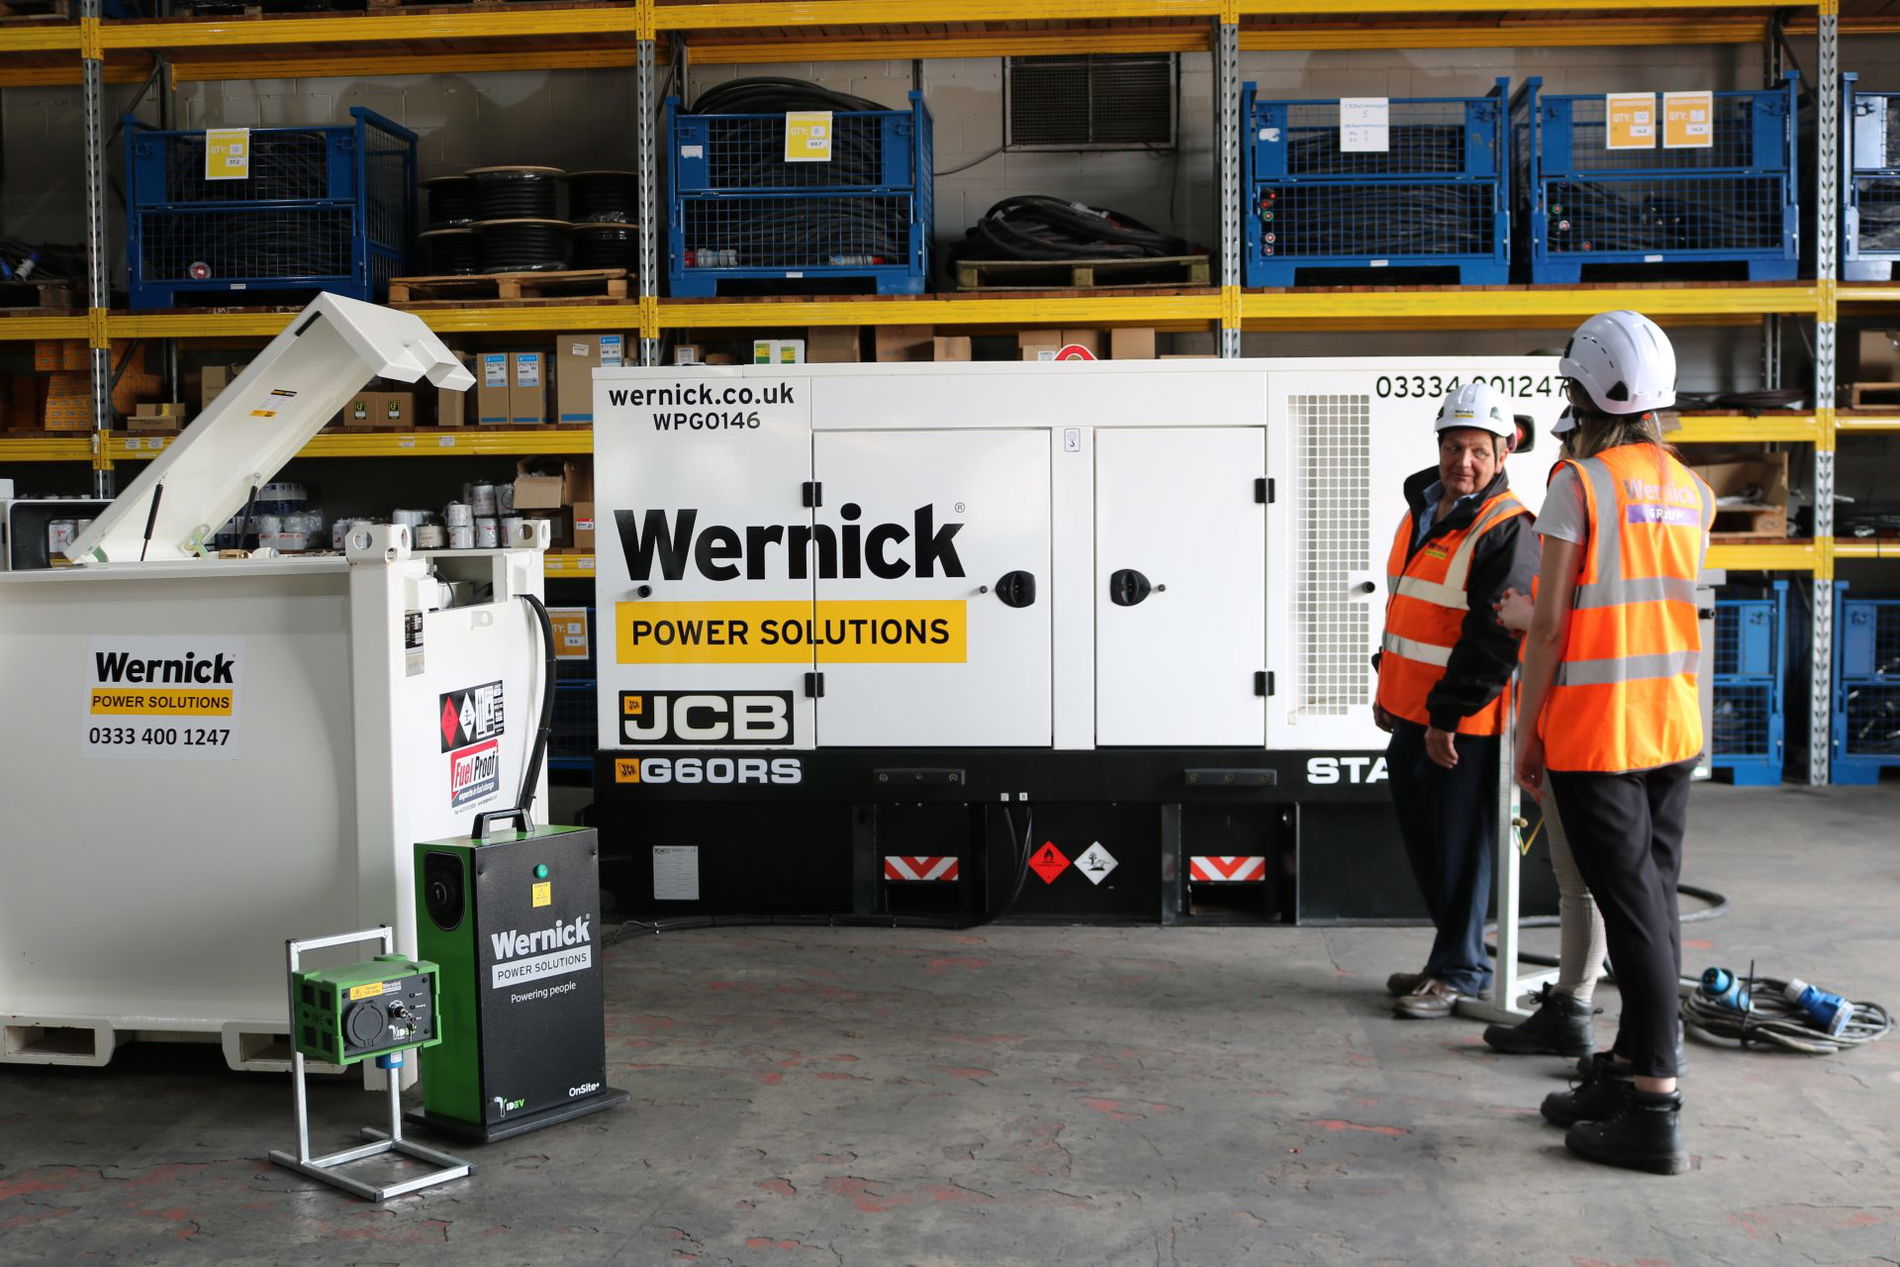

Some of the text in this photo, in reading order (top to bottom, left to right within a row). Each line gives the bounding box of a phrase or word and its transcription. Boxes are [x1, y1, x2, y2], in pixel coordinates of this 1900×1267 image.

[608, 382, 795, 407] wernick.co.uk
[1376, 375, 1568, 399] 0333401247
[613, 502, 966, 582] Wernick
[632, 618, 950, 646] POWER SOLUTIONS
[95, 651, 235, 684] Wernick
[92, 695, 230, 709] POWER SOLUTIONS
[624, 695, 790, 741] JCB
[90, 727, 231, 746] 0333 400 1247
[454, 751, 496, 789] Fuel Proof
[491, 916, 591, 960] Wernick
[498, 953, 587, 980] POWER SOLUTIONS
[511, 981, 577, 1004] Powering people
